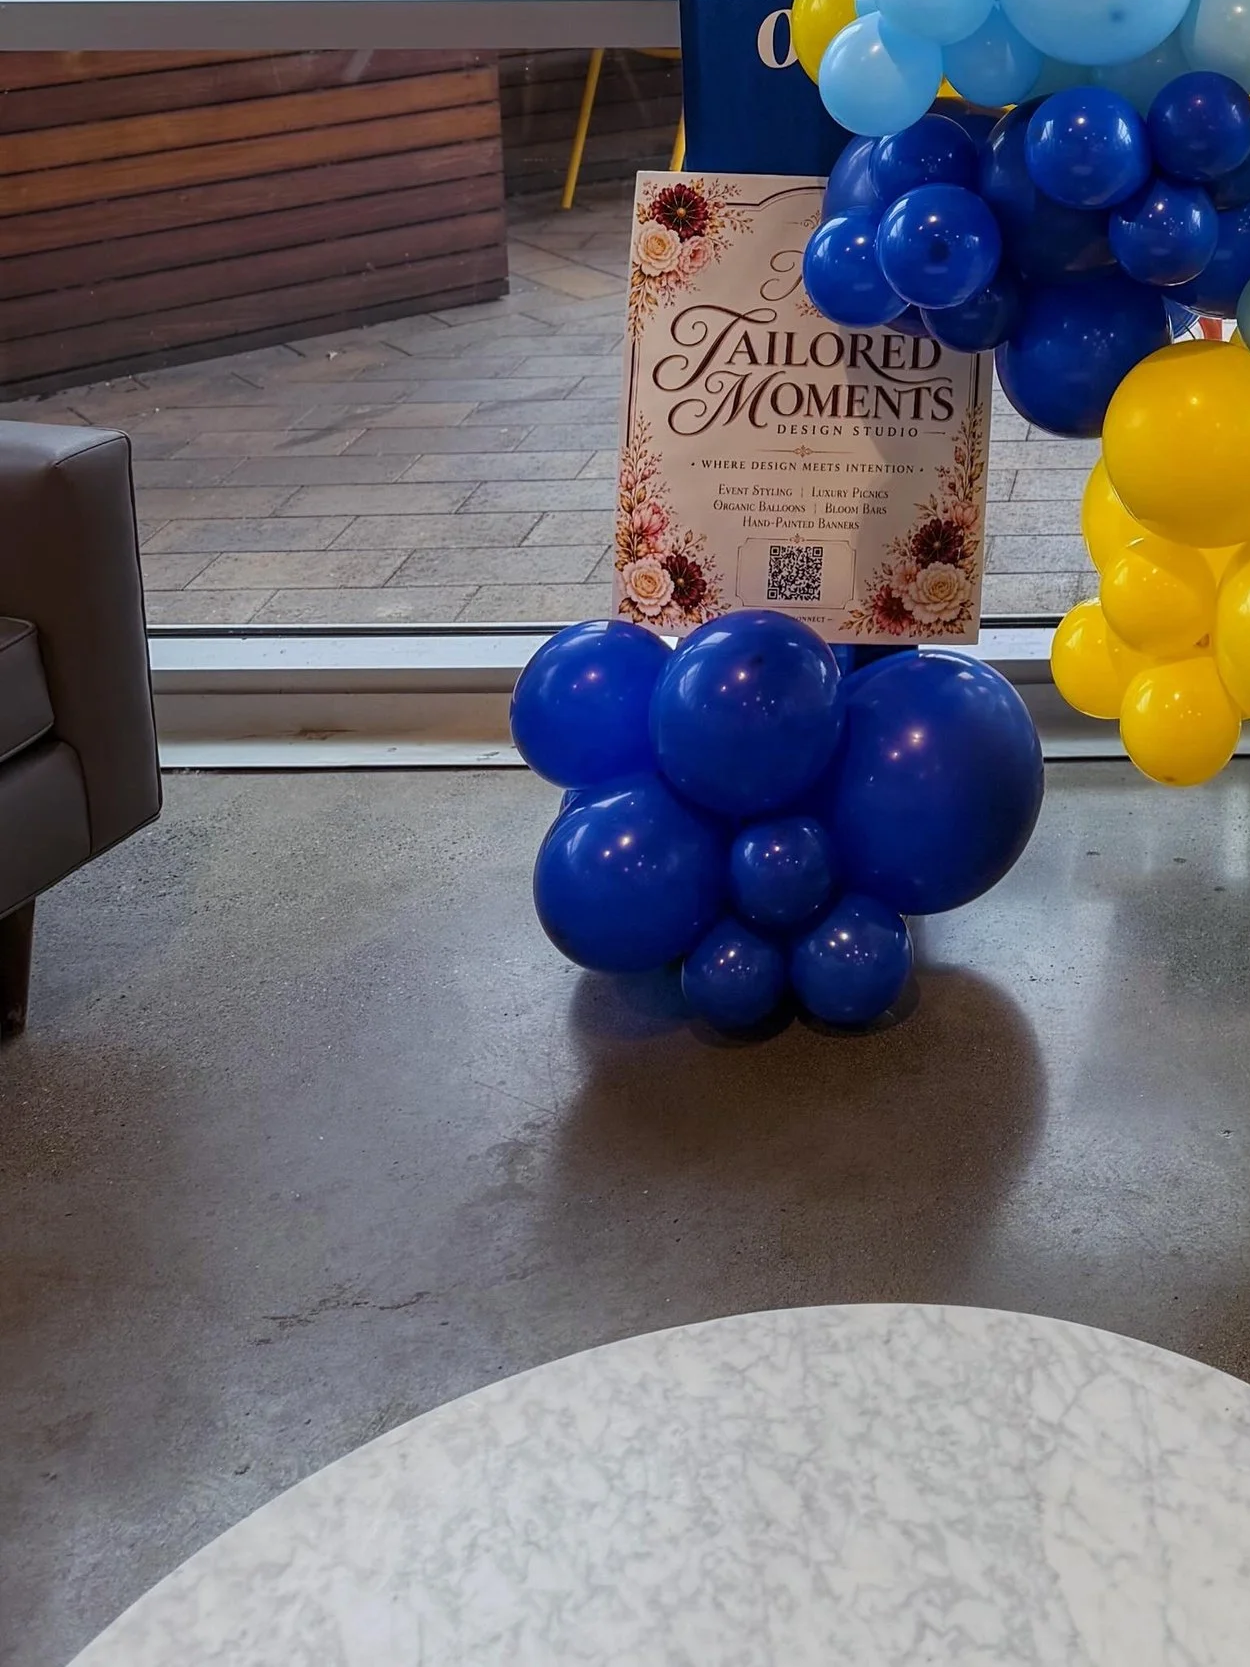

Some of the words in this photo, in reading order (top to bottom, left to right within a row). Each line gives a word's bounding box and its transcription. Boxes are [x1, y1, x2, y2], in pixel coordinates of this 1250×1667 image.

[652, 305, 953, 392] TAILORED
[668, 370, 955, 436] MOMENTS
[777, 424, 843, 436] DESIGN
[853, 426, 919, 438] STUDIO
[701, 459, 746, 470] WHERE
[751, 461, 797, 471] DESIGN
[802, 462, 840, 473] MEETS
[846, 463, 914, 474] INTENTION
[718, 484, 749, 496] EVENT
[752, 485, 793, 497] STYLING
[812, 486, 848, 499] LUXURY
[852, 487, 889, 499] PICNICS
[713, 499, 755, 511] ORGANIC
[758, 500, 806, 513] BALLOONS
[825, 503, 858, 514] BLOOM
[862, 504, 887, 515] BARS
[818, 517, 860, 530] BANNERS
